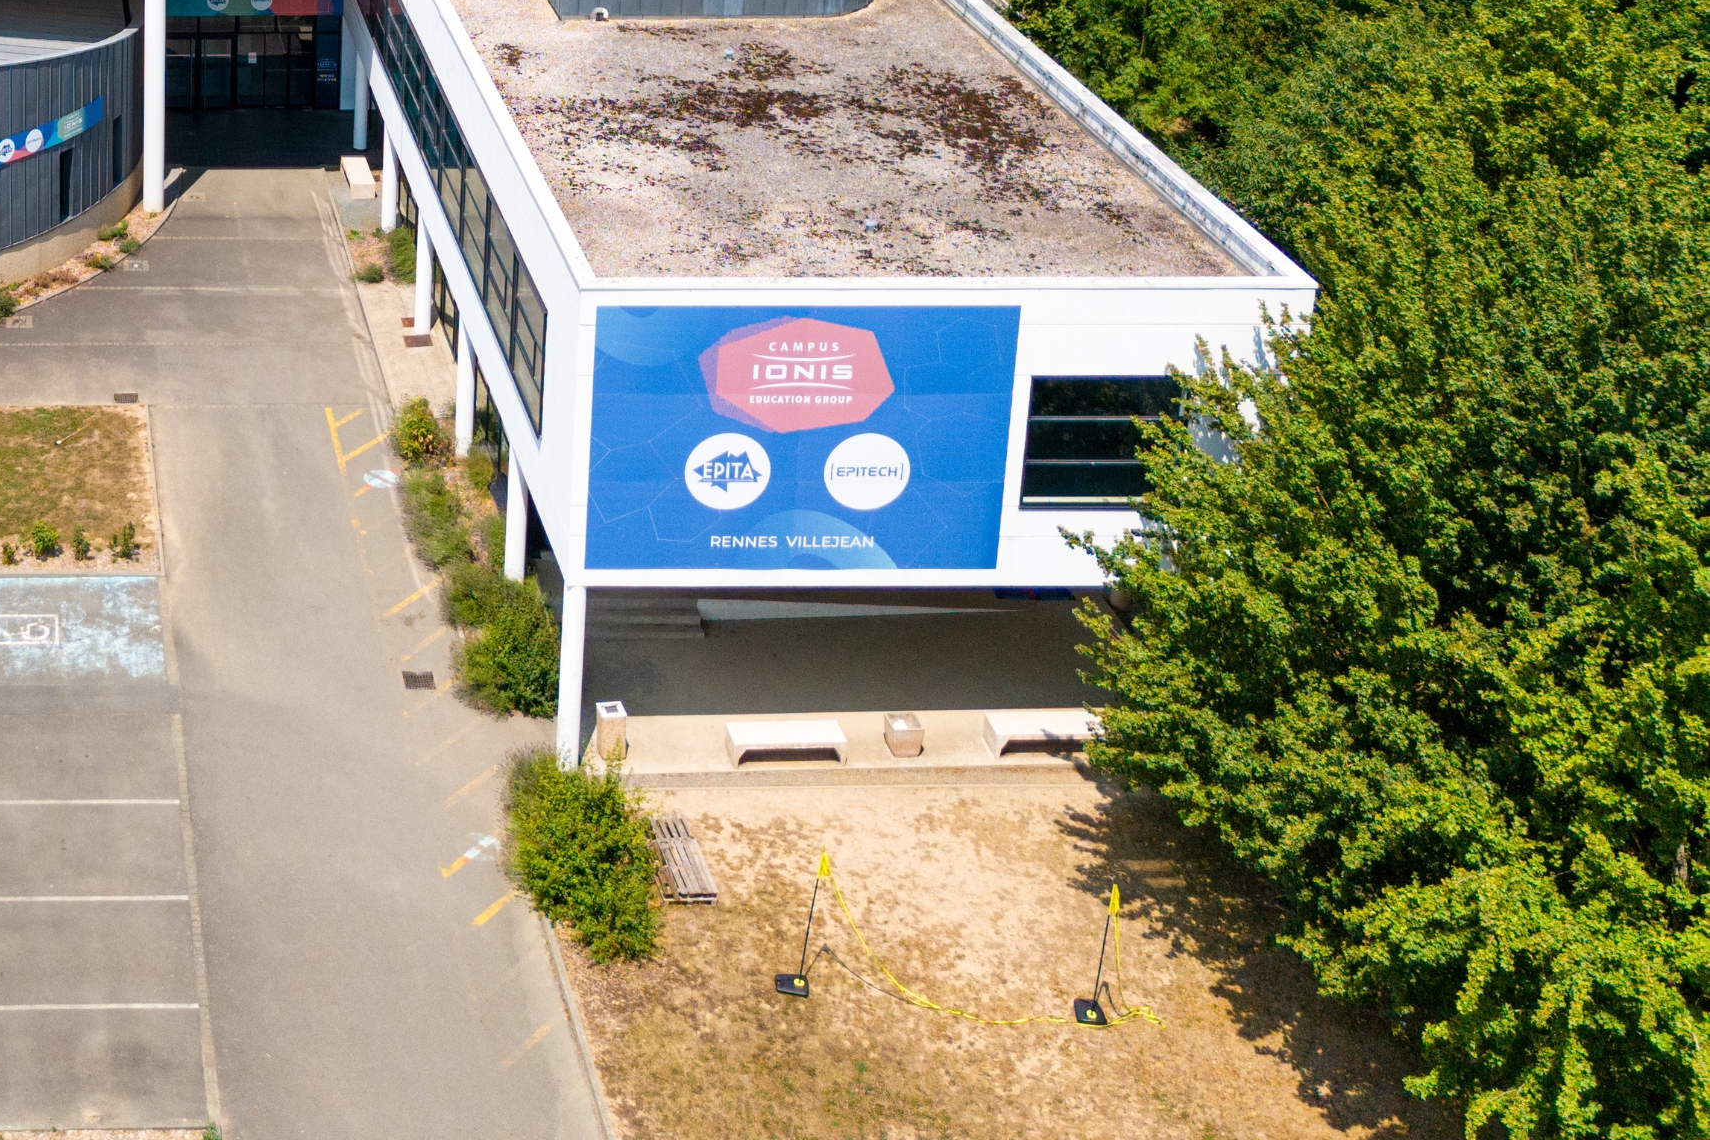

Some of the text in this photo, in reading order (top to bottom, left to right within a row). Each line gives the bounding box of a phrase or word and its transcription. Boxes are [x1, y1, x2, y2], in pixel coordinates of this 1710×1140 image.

[768, 342, 839, 352] CAMPUS
[752, 364, 853, 380] IONIS
[749, 395, 853, 404] EDUCATION GROUP
[702, 462, 755, 479] EPITA
[710, 535, 874, 548] RENNES VILLEJEAN
